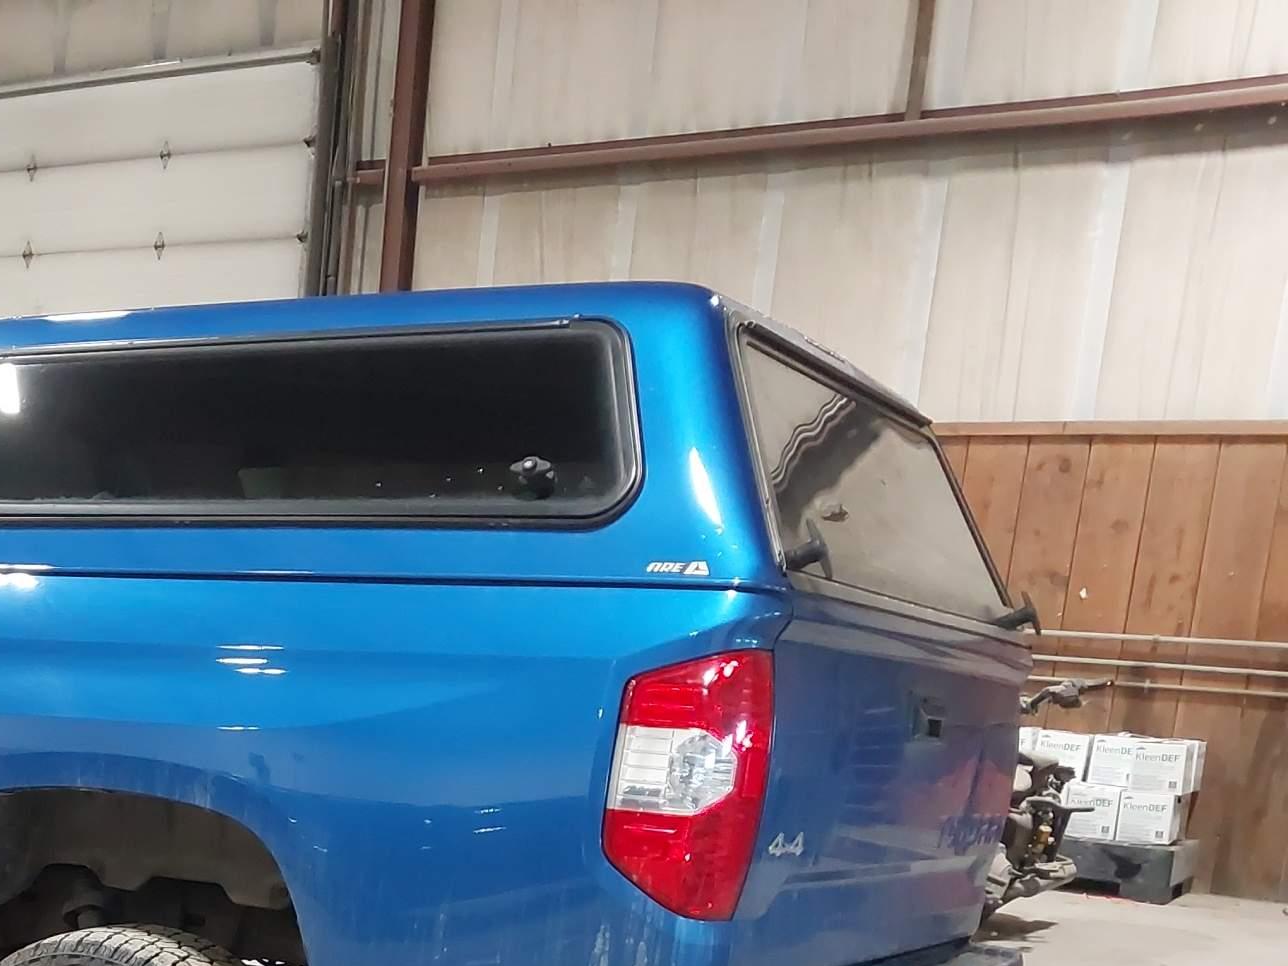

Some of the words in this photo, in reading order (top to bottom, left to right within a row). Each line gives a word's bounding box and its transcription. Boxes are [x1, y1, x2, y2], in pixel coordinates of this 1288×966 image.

[1096, 744, 1133, 755] KleenDE
[1135, 751, 1180, 763] KleenDEF
[1123, 802, 1168, 812] KleenDEF
